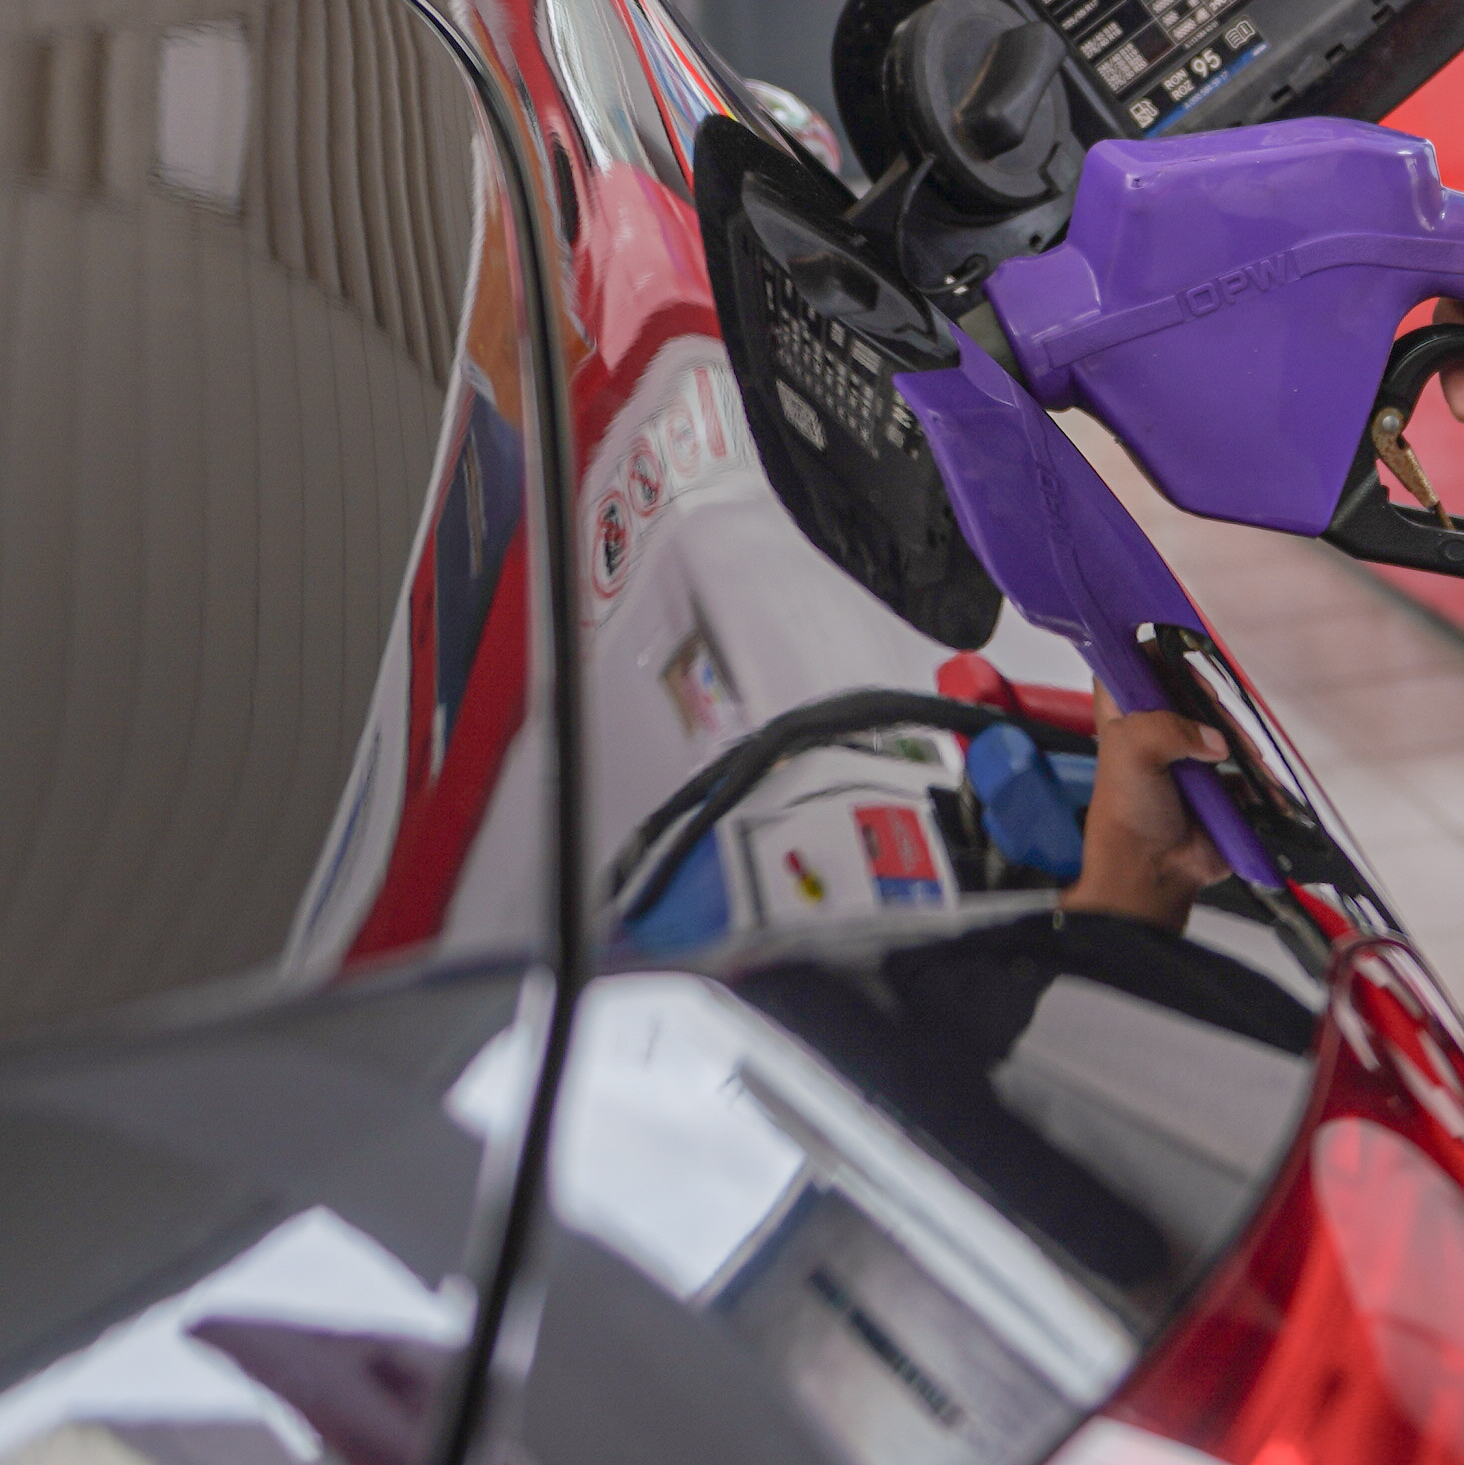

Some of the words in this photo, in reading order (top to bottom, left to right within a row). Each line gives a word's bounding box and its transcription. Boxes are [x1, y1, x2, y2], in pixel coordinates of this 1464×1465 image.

[1192, 49, 1223, 78] 95
[1164, 69, 1187, 90] RON
[1172, 80, 1194, 101] ROZ
[1187, 255, 1286, 315] OPW
